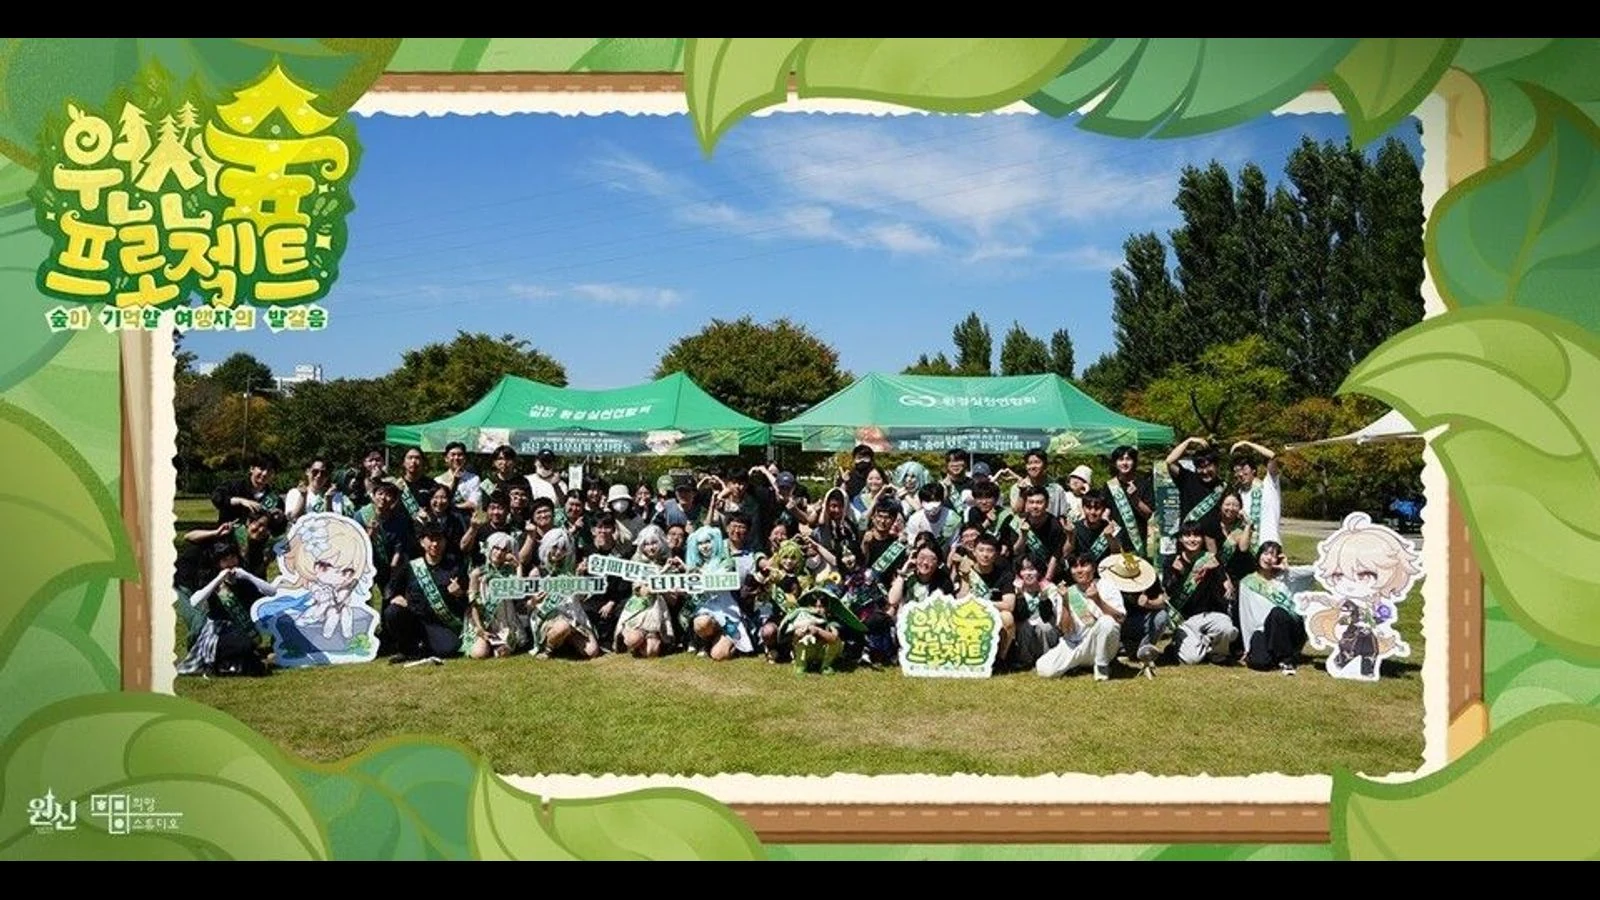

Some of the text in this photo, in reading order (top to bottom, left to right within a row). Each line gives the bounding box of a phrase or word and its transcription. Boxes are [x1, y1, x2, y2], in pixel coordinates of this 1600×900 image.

[591, 556, 623, 573] 함께
[490, 577, 604, 595] 원신과 여행자가
[651, 574, 738, 590] 더 나은 미래
[907, 640, 985, 667] 프로젝트
